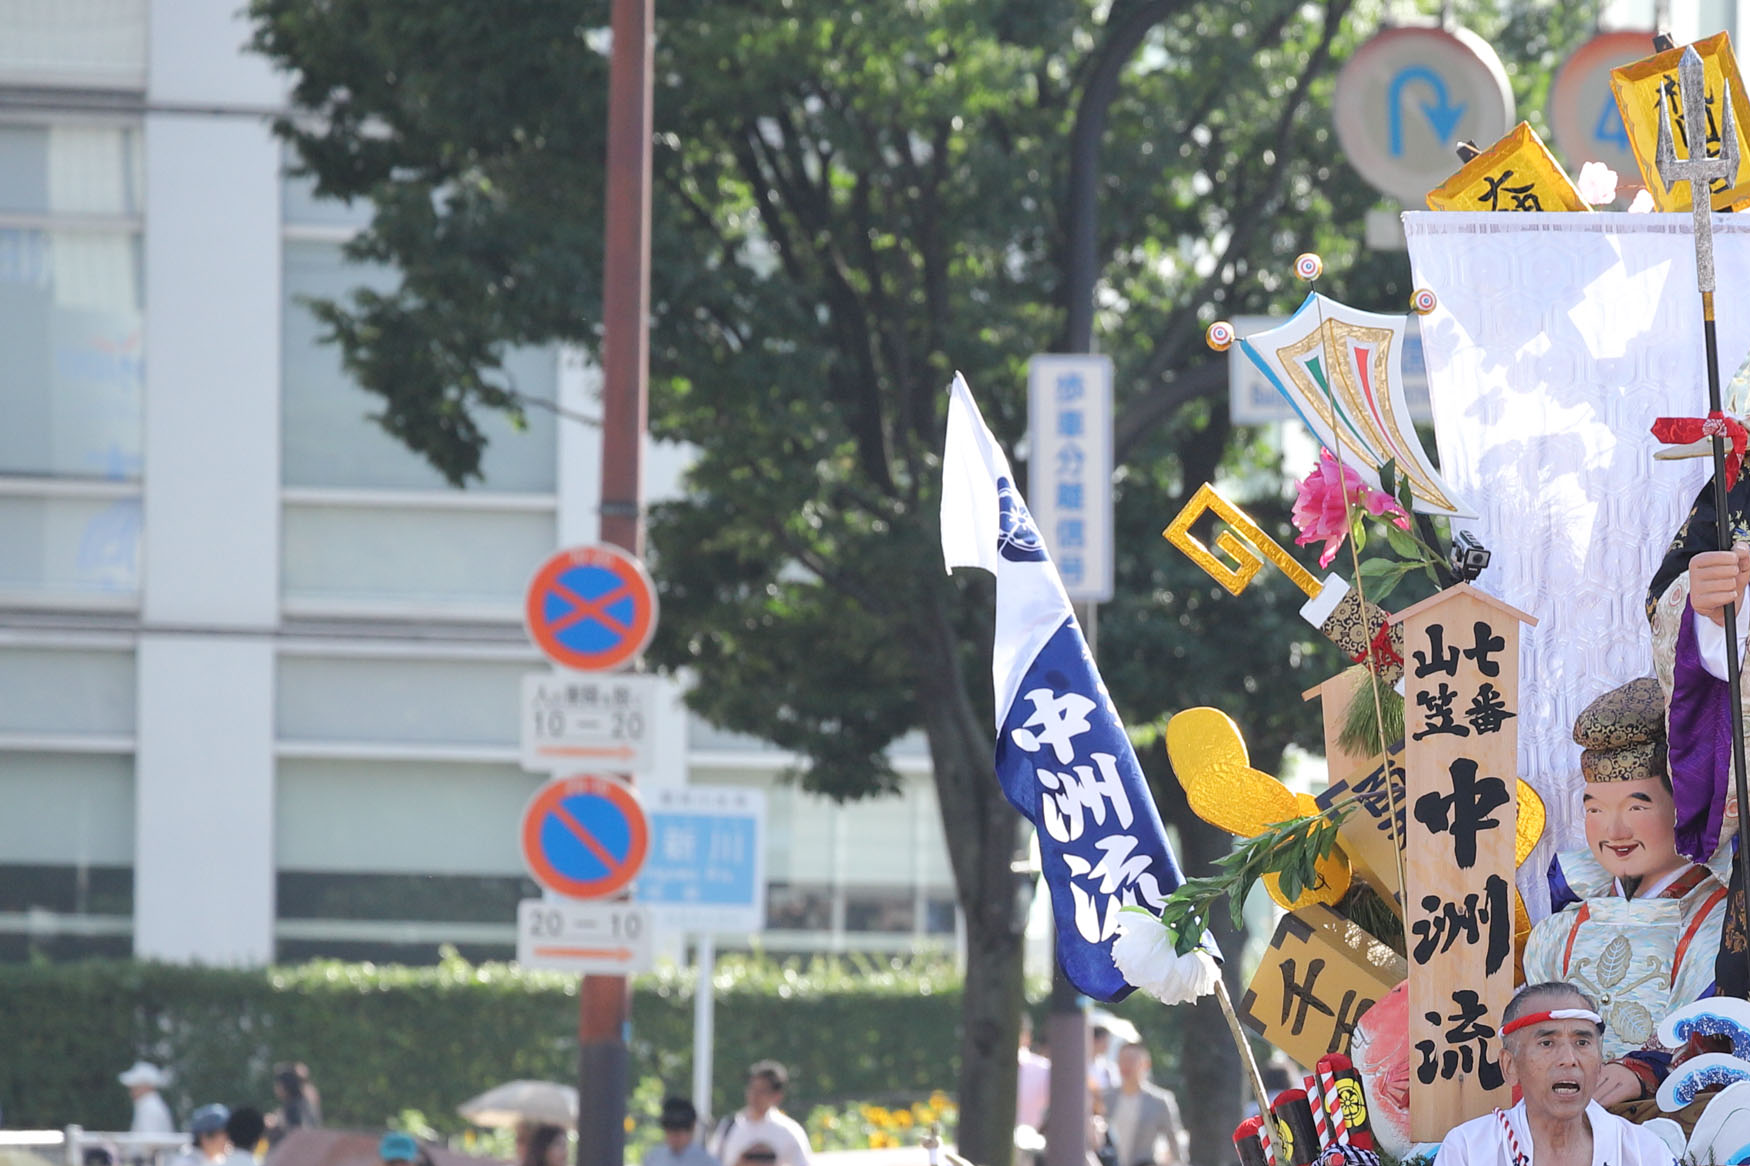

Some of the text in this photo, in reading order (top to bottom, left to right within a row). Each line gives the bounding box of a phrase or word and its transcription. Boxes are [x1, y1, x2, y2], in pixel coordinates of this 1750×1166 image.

[1056, 372, 1085, 586] 歩車分離信号
[1413, 625, 1469, 740] 山笠
[1464, 621, 1516, 734] 七番
[1011, 688, 1168, 943] 中洲流
[1413, 757, 1514, 1092] 中洲流
